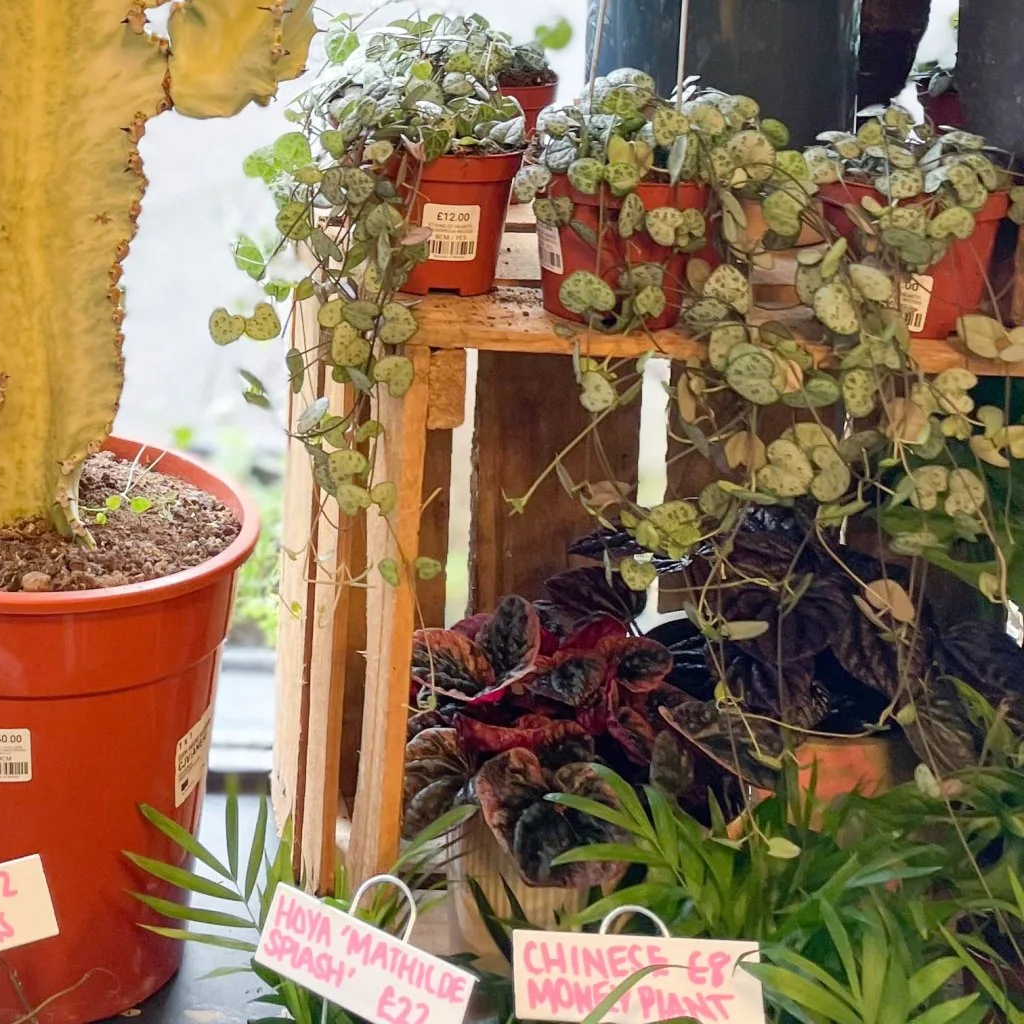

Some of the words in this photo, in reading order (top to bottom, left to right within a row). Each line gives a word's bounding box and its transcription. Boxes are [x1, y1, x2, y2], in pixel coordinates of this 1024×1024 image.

[437, 212, 470, 222] £12.00
[274, 895, 332, 947] HOYA
[523, 940, 669, 978] CHINESE
[687, 950, 731, 988] £8
[636, 985, 734, 1020] PLANT
